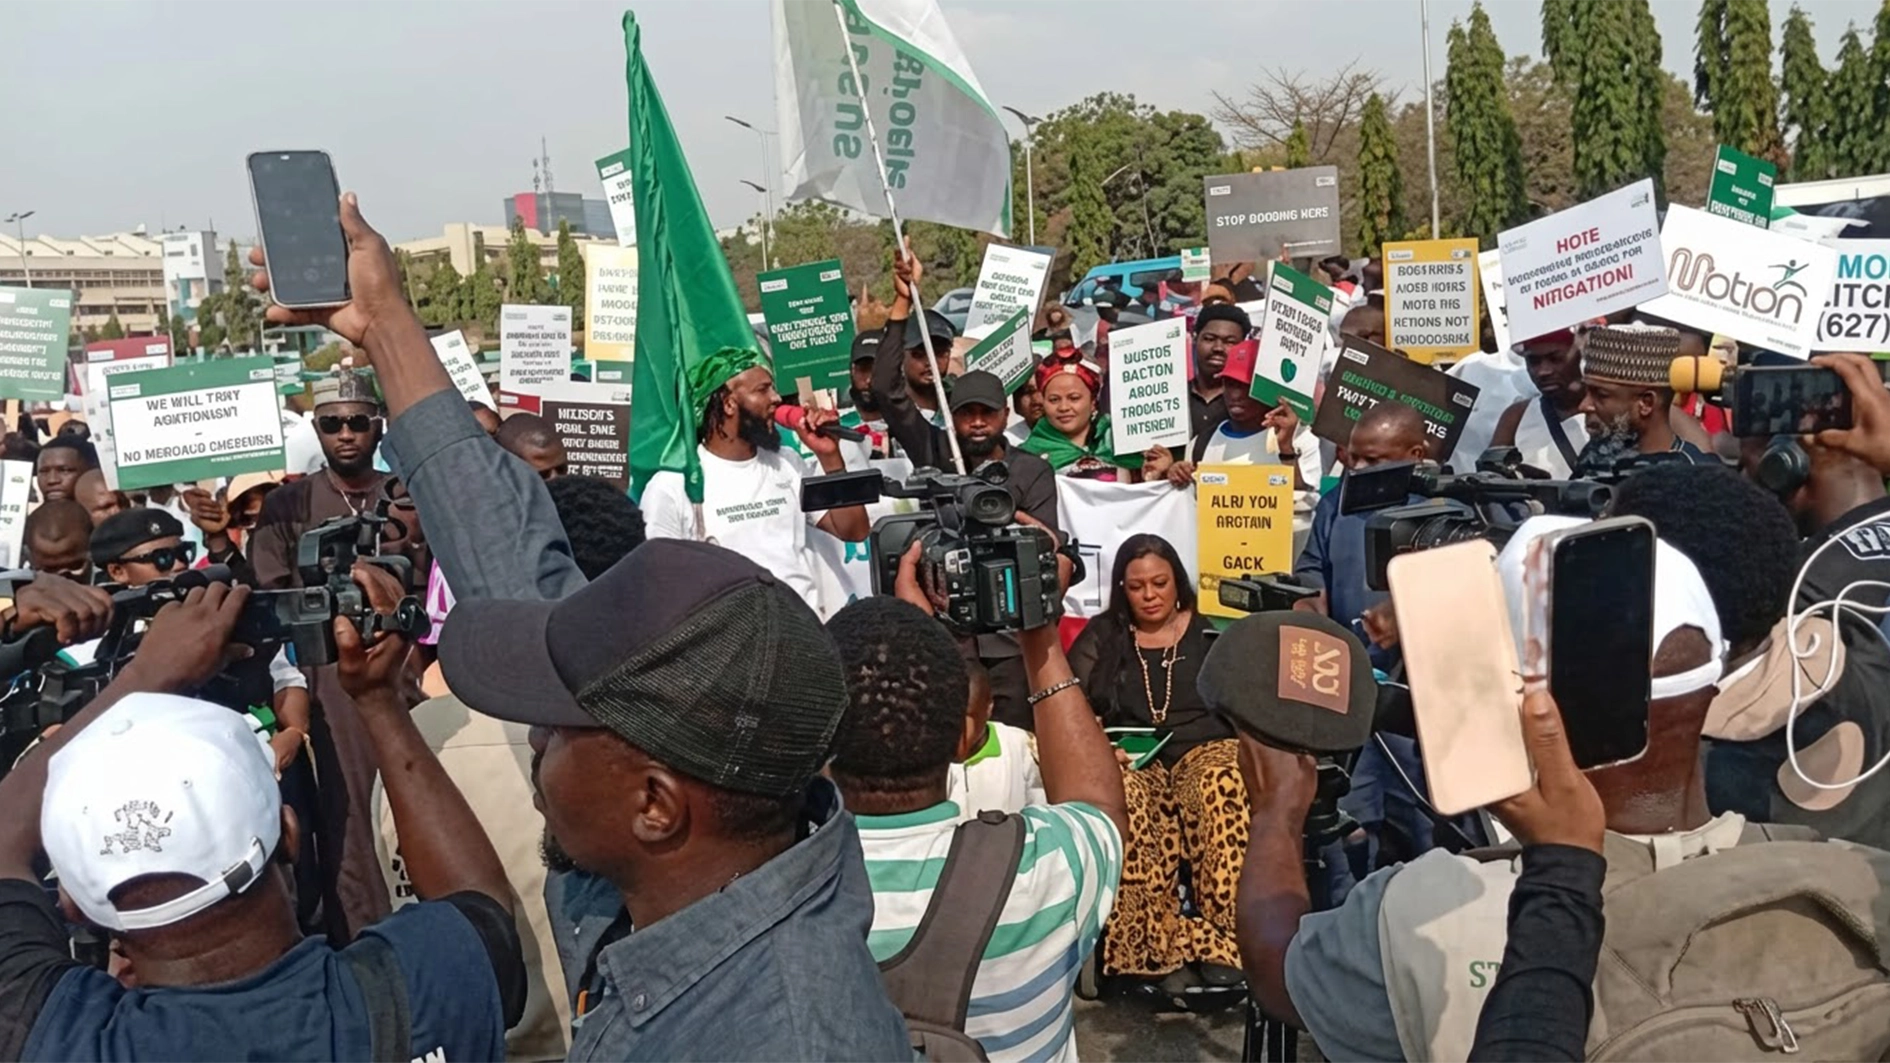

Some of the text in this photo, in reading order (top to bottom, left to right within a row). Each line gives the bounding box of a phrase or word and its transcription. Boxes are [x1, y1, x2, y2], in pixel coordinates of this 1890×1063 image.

[1216, 213, 1246, 227] STOP
[1837, 254, 1890, 280] MO
[1667, 247, 1803, 325] Motion
[1445, 315, 1470, 327] NOT
[1816, 311, 1890, 343] (627)
[146, 400, 169, 411] WE
[123, 450, 142, 463] NO
[1223, 555, 1265, 571] GACK
